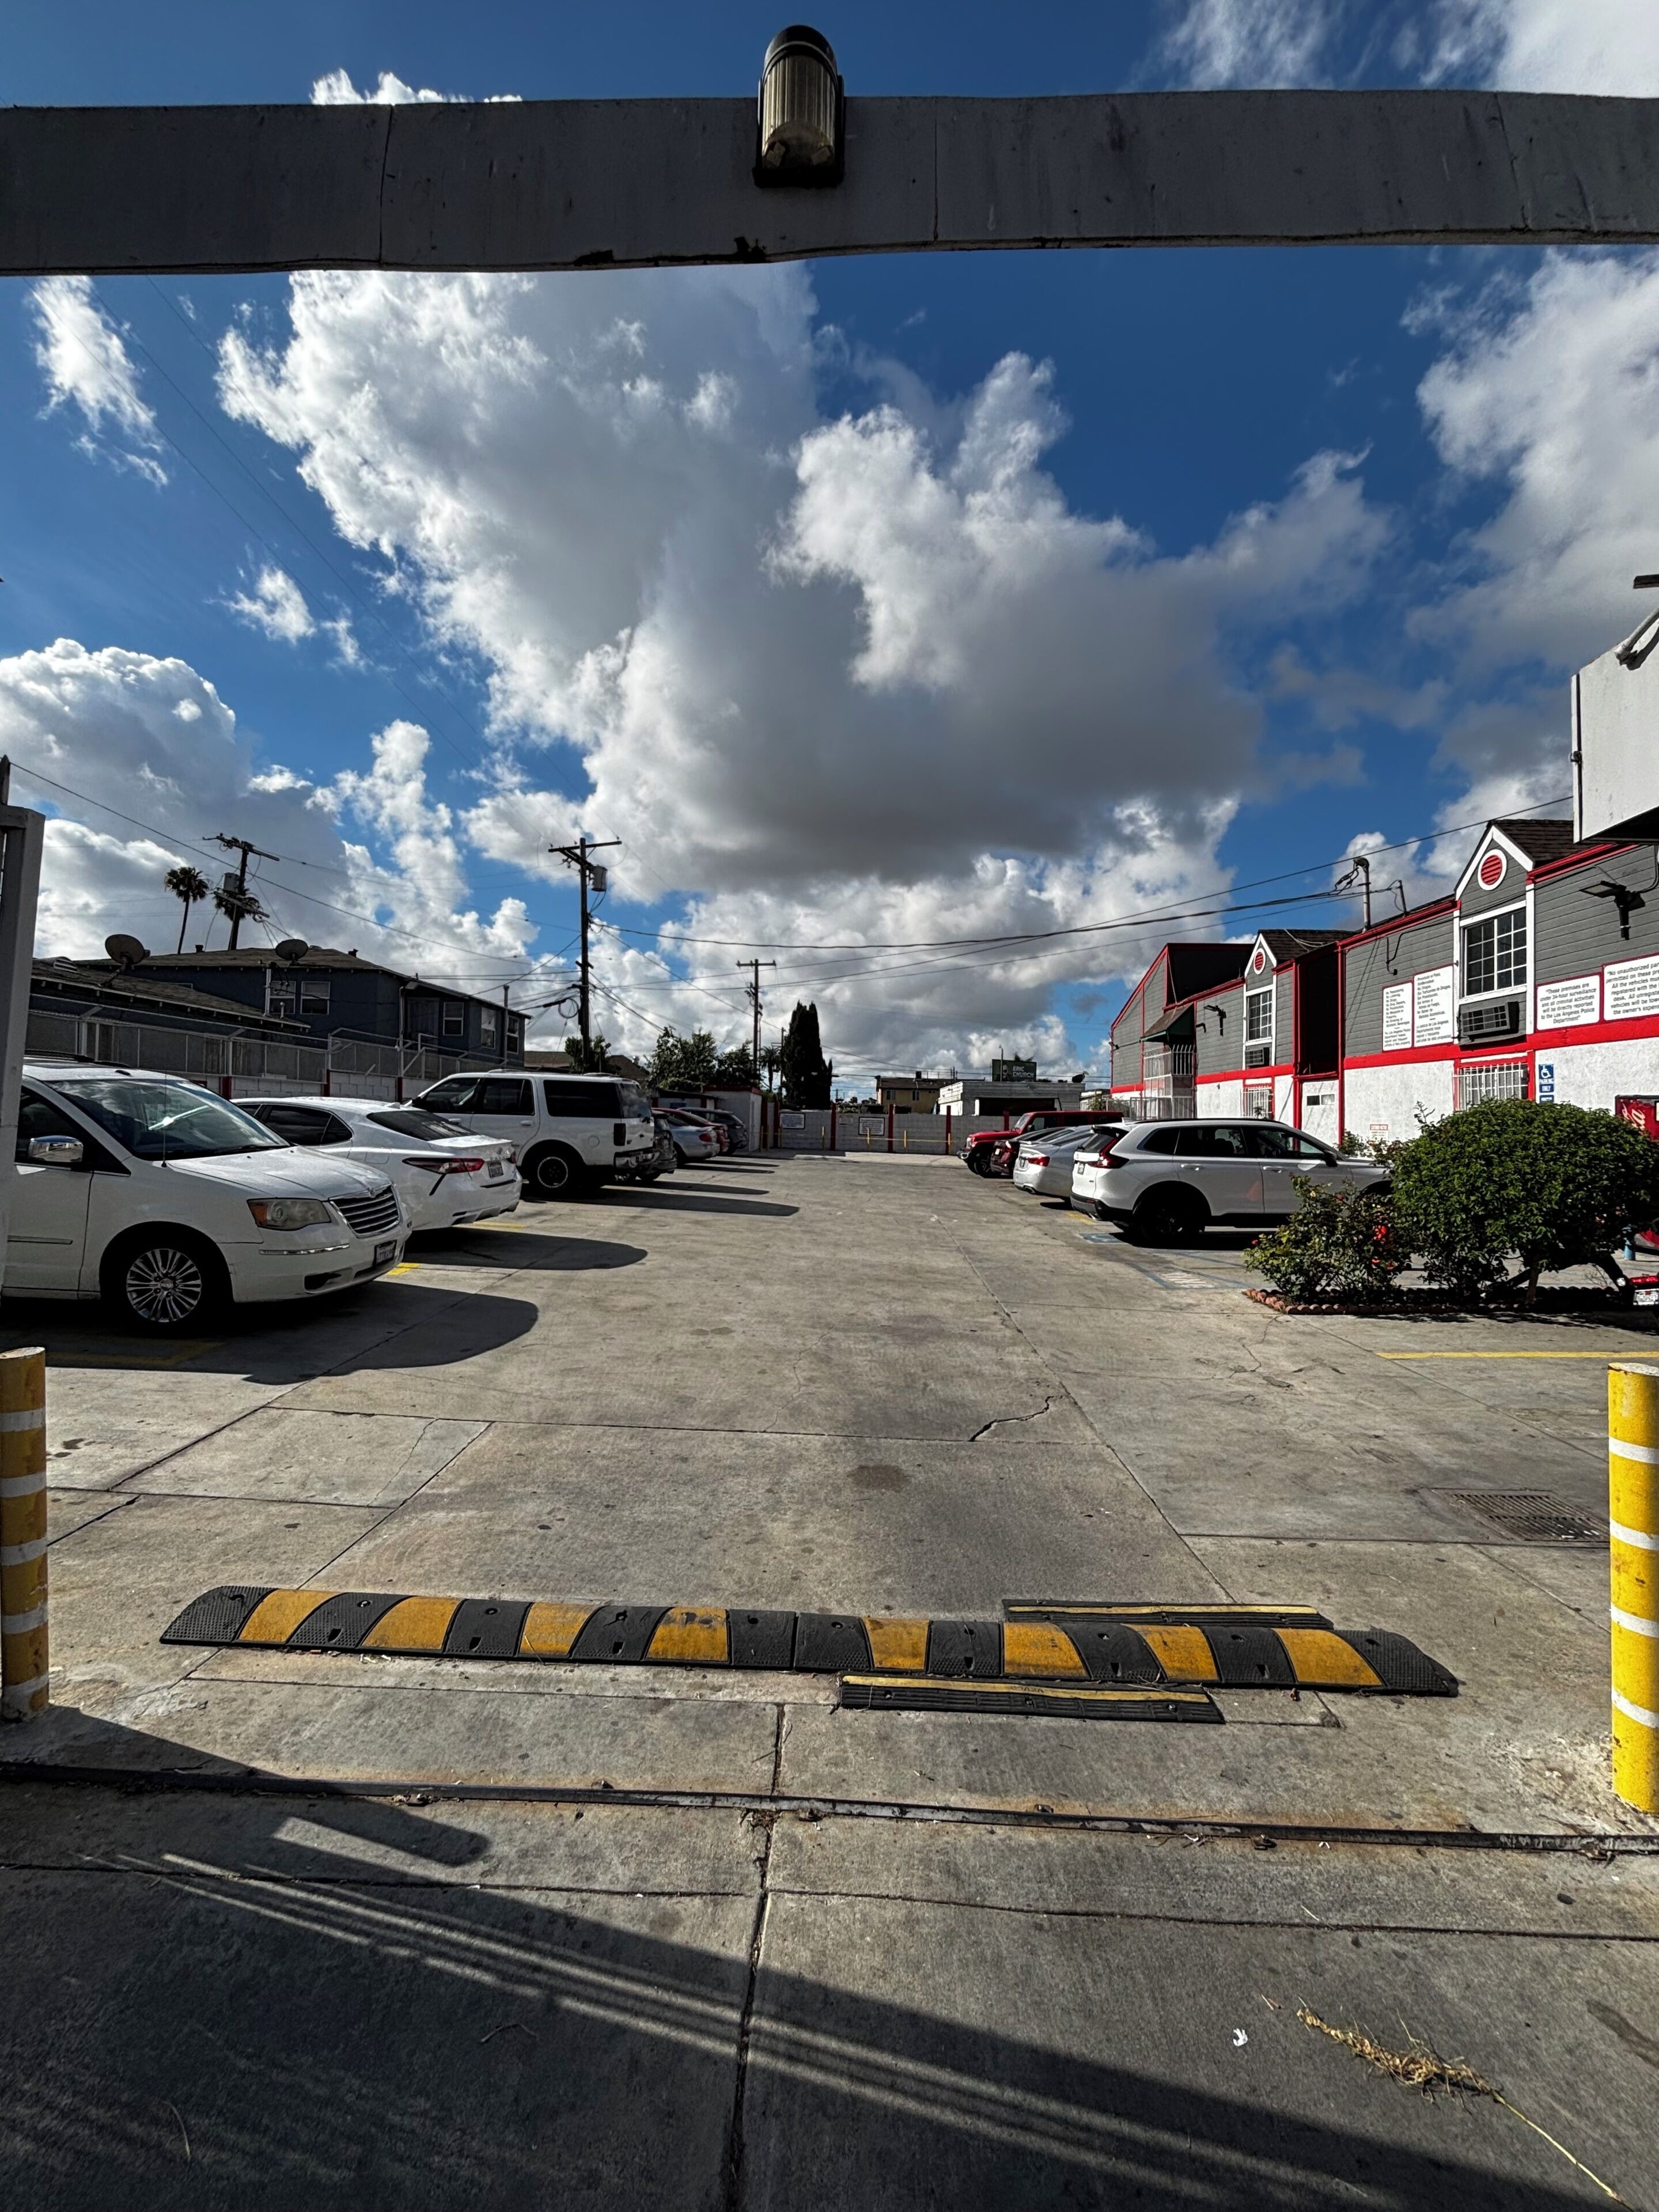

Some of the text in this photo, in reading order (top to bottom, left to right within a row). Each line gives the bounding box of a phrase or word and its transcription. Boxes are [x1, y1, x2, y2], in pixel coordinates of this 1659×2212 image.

[1617, 964, 1649, 975] unauthorized
[1606, 975, 1628, 984] permitted
[1611, 987, 1635, 995] registered
